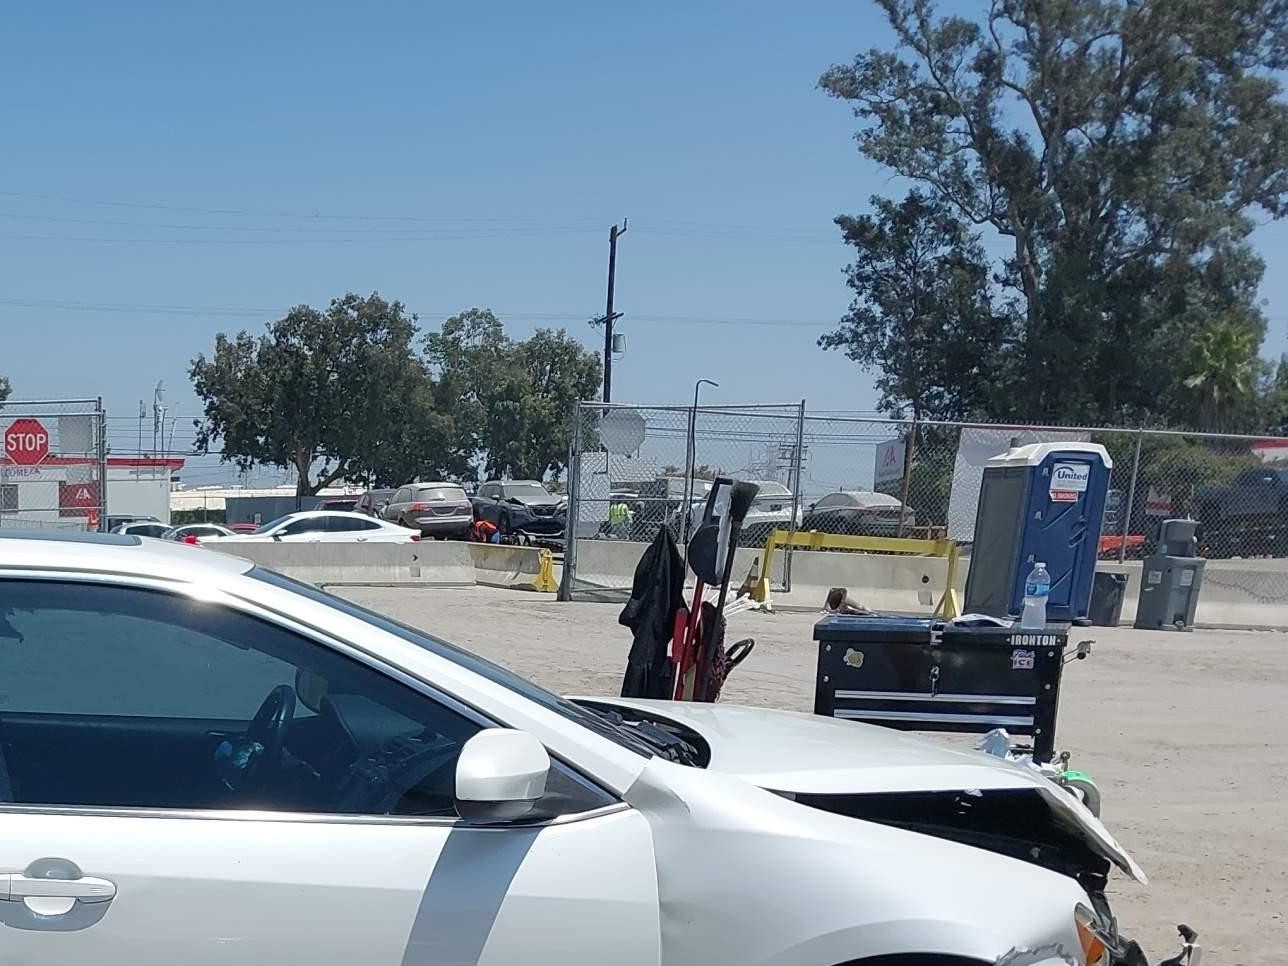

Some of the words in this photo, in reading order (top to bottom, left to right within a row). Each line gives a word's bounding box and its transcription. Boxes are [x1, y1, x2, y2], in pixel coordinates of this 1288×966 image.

[7, 433, 47, 451] STOP
[1057, 470, 1088, 481] United
[1010, 634, 1057, 646] IRONTON
